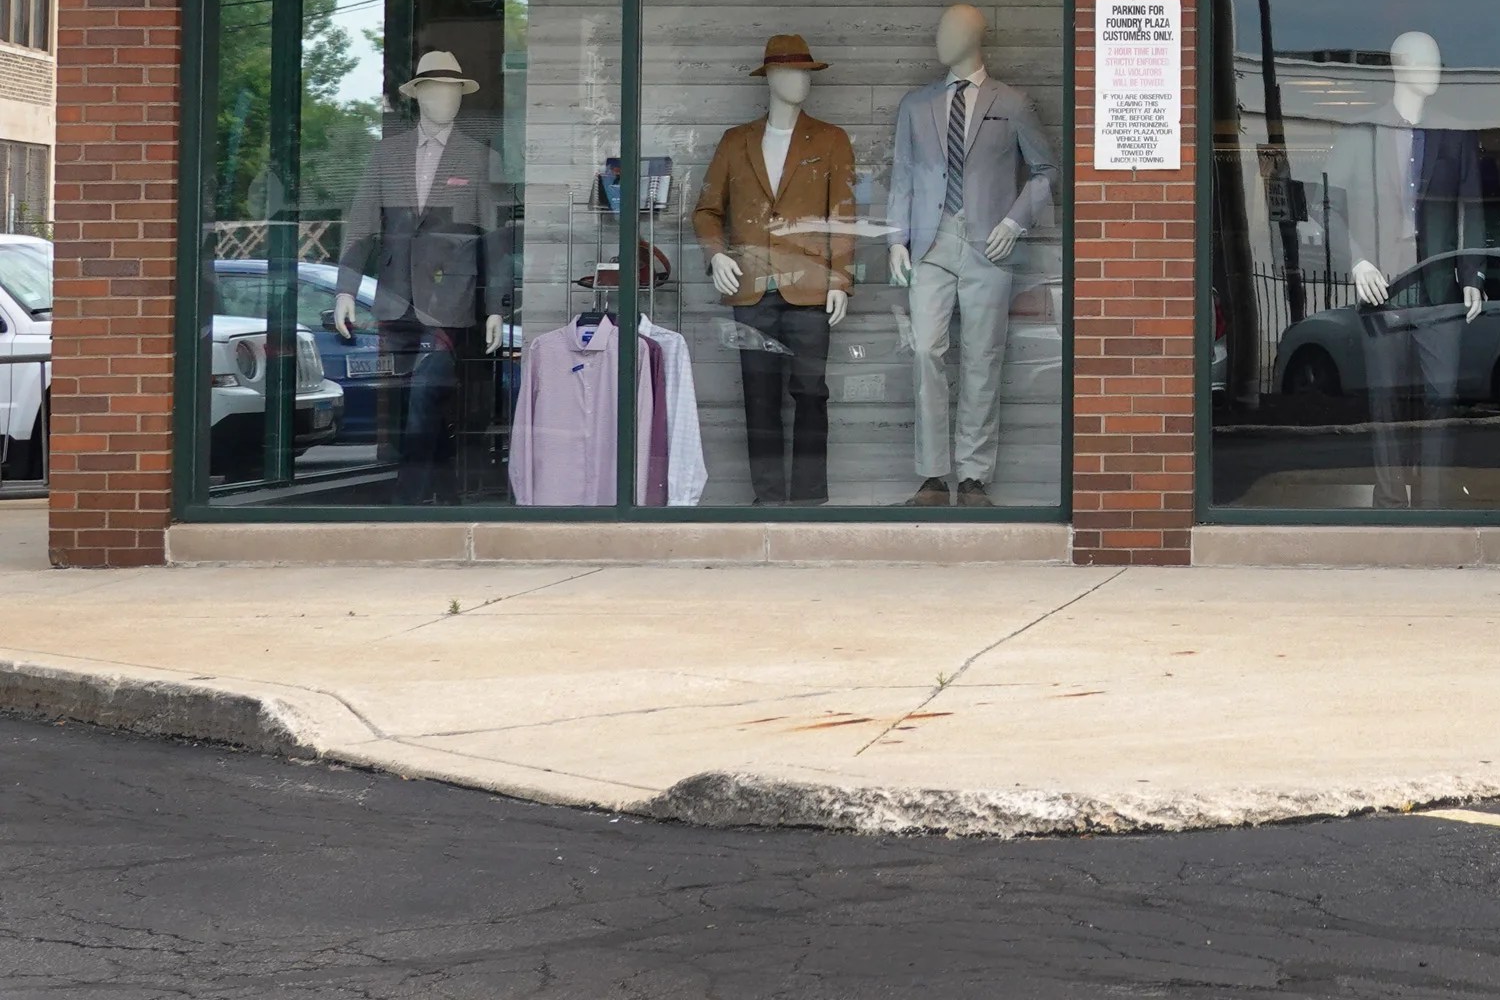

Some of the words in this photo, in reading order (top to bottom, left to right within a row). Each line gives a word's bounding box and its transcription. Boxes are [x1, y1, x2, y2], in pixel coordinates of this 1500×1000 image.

[1112, 5, 1146, 15] PARKING
[1148, 5, 1164, 15] FOR
[1106, 18, 1142, 28] FOUNDRY
[1144, 18, 1170, 28] PLAZA
[1102, 30, 1151, 41] CUSTOMERS
[1153, 30, 1174, 41] ONLY.
[1107, 47, 1112, 56] 2
[1114, 47, 1132, 56] HOUR
[1134, 47, 1150, 56] TIME
[1151, 47, 1169, 56] LIMIT
[1105, 58, 1135, 66] STRICTLY
[1114, 68, 1126, 76] ALL
[1128, 68, 1162, 76] VIOLATORS
[1112, 78, 1127, 87] WILL
[1130, 78, 1139, 87] BE
